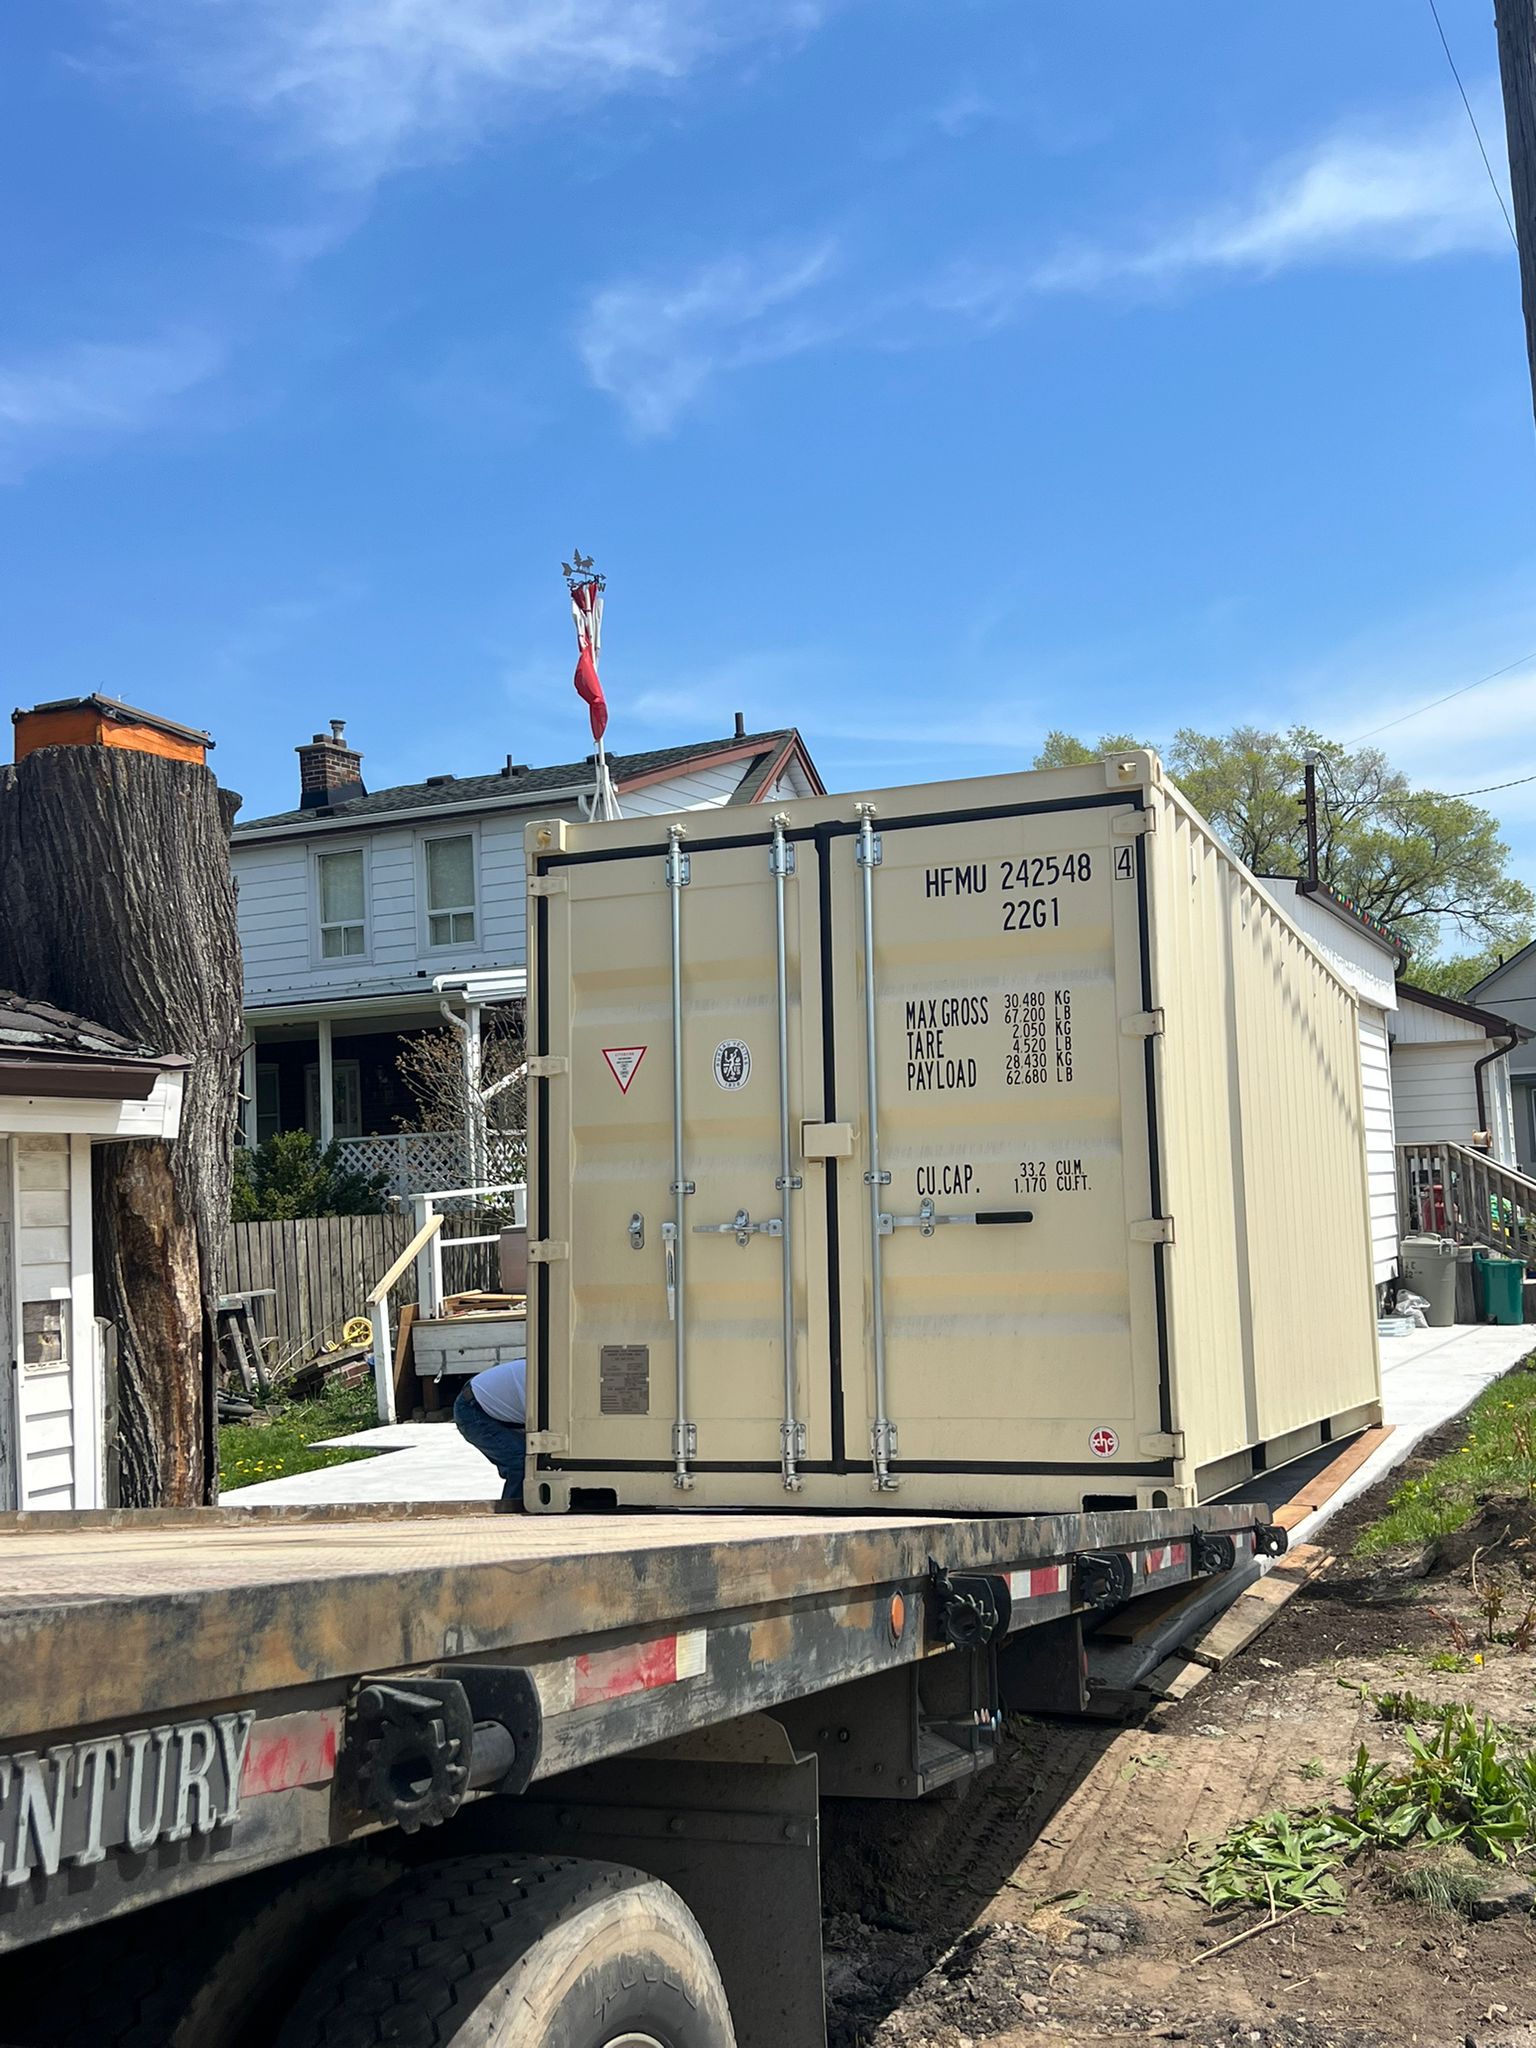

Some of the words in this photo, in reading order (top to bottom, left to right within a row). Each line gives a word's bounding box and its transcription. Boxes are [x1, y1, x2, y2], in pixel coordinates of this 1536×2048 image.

[925, 863, 987, 898] HFMU
[1000, 853, 1092, 890] 242548
[1117, 848, 1132, 877] 4
[1002, 897, 1060, 931] 22G1
[1055, 990, 1071, 1005] KG
[905, 999, 938, 1030] MAX
[941, 996, 989, 1027] GROSS
[1055, 1005, 1071, 1020] LB
[1055, 1020, 1072, 1036] KG
[906, 1029, 945, 1060] TARE
[1055, 1036, 1072, 1052] LB
[1056, 1051, 1073, 1067] KG
[906, 1058, 977, 1091] PAYLOAD
[1056, 1066, 1074, 1083] LB
[1019, 1161, 1046, 1178] 33.2
[916, 1164, 981, 1196] CU.CAP.
[1013, 1177, 1047, 1194] 1.170
[0, 1709, 256, 1886] NTURY
